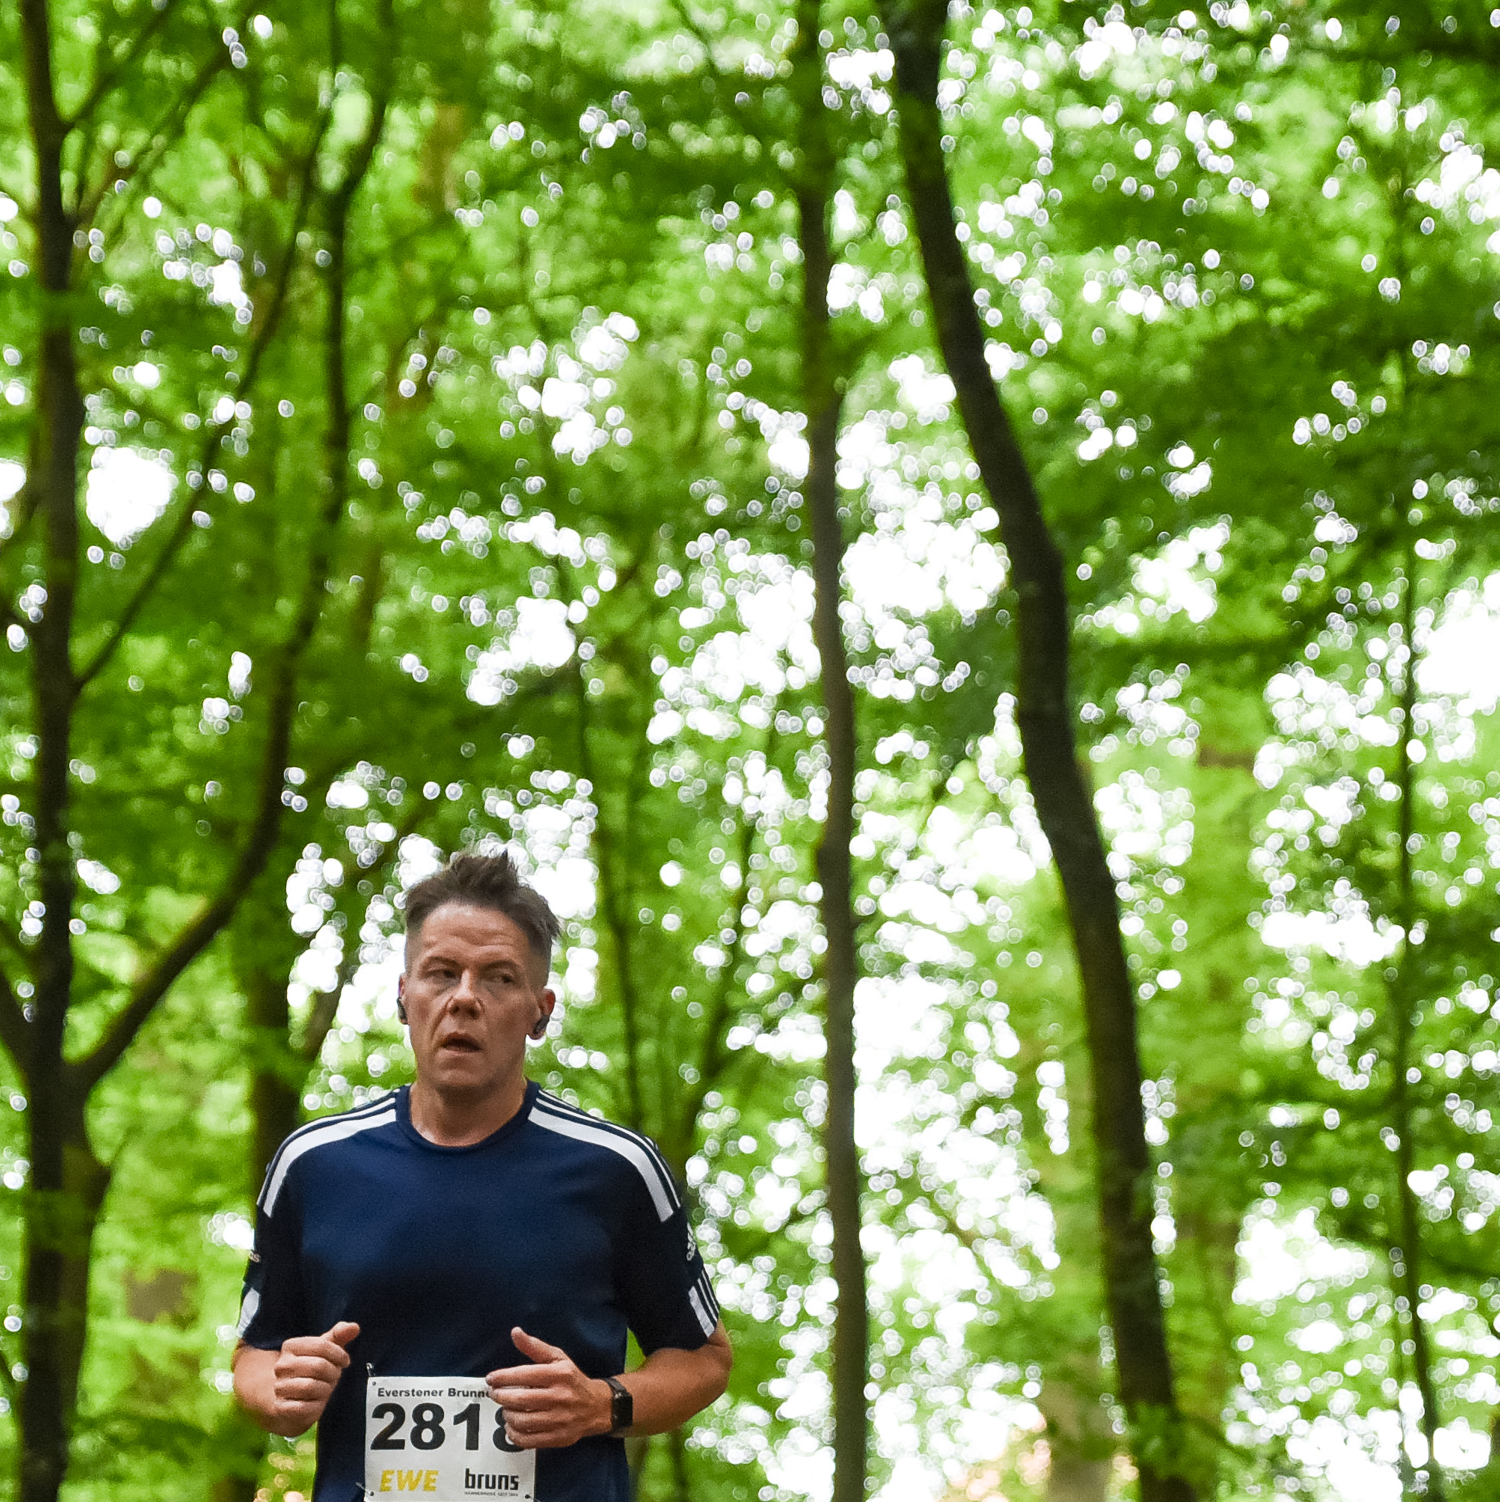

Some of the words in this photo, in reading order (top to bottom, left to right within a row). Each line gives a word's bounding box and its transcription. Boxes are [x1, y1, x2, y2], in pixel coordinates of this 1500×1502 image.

[376, 1386, 444, 1398] Everstener
[379, 1469, 440, 1493] EWE
[464, 1467, 520, 1491] bruns
